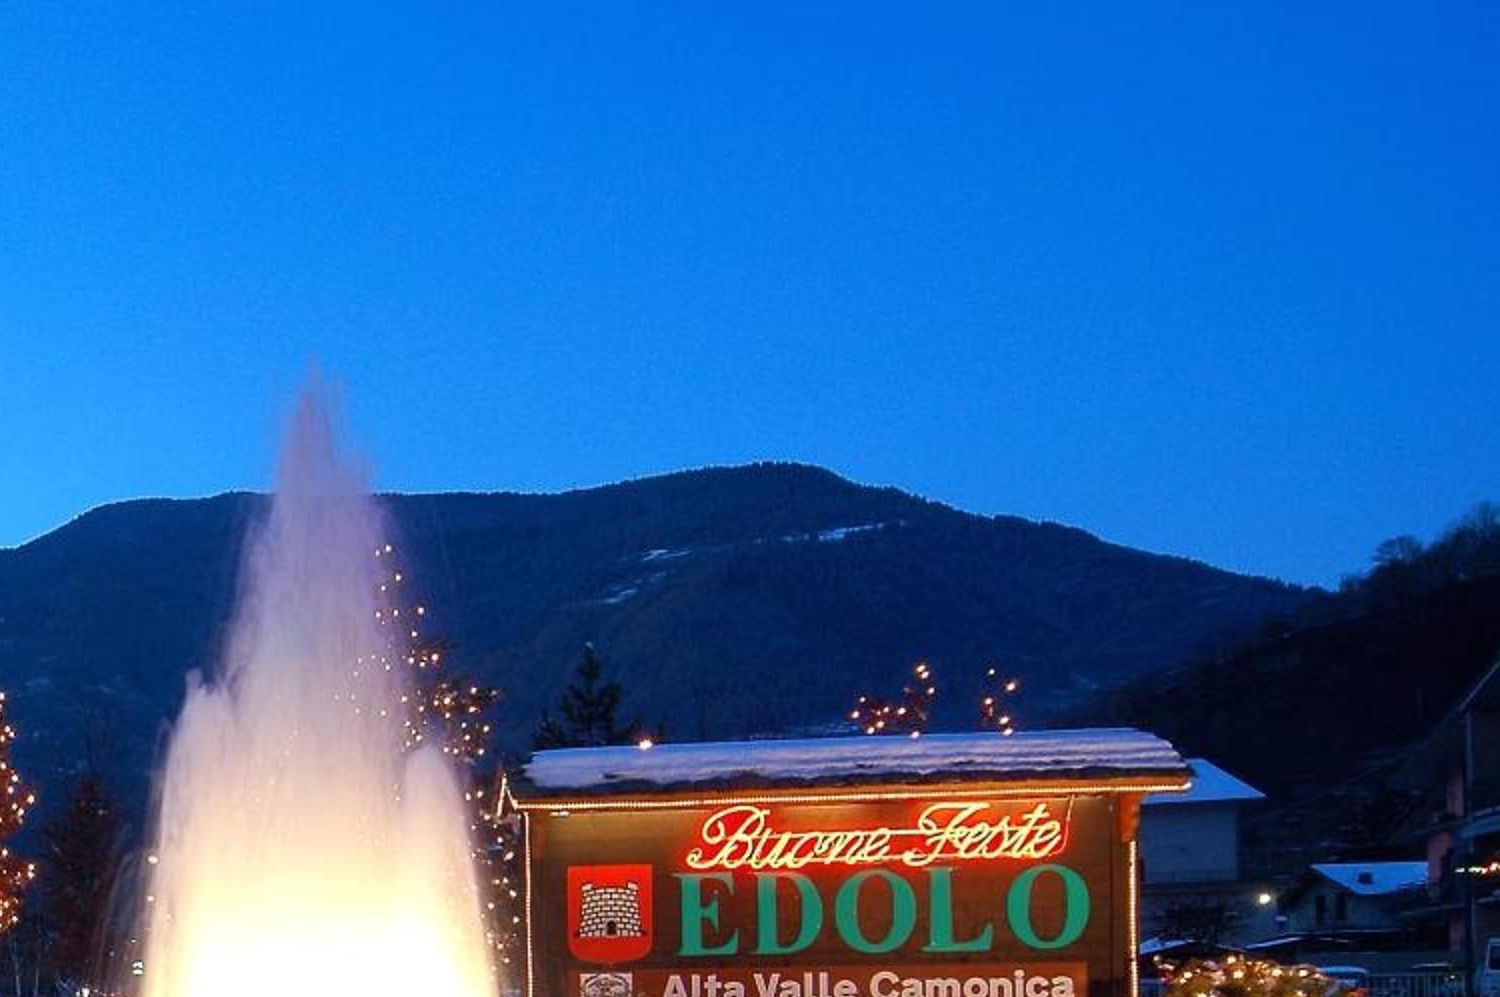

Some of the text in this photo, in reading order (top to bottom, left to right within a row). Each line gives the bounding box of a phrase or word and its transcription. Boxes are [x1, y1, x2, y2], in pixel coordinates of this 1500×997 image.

[687, 802, 1063, 867] Buone Feste
[674, 863, 1092, 957] EDOLO
